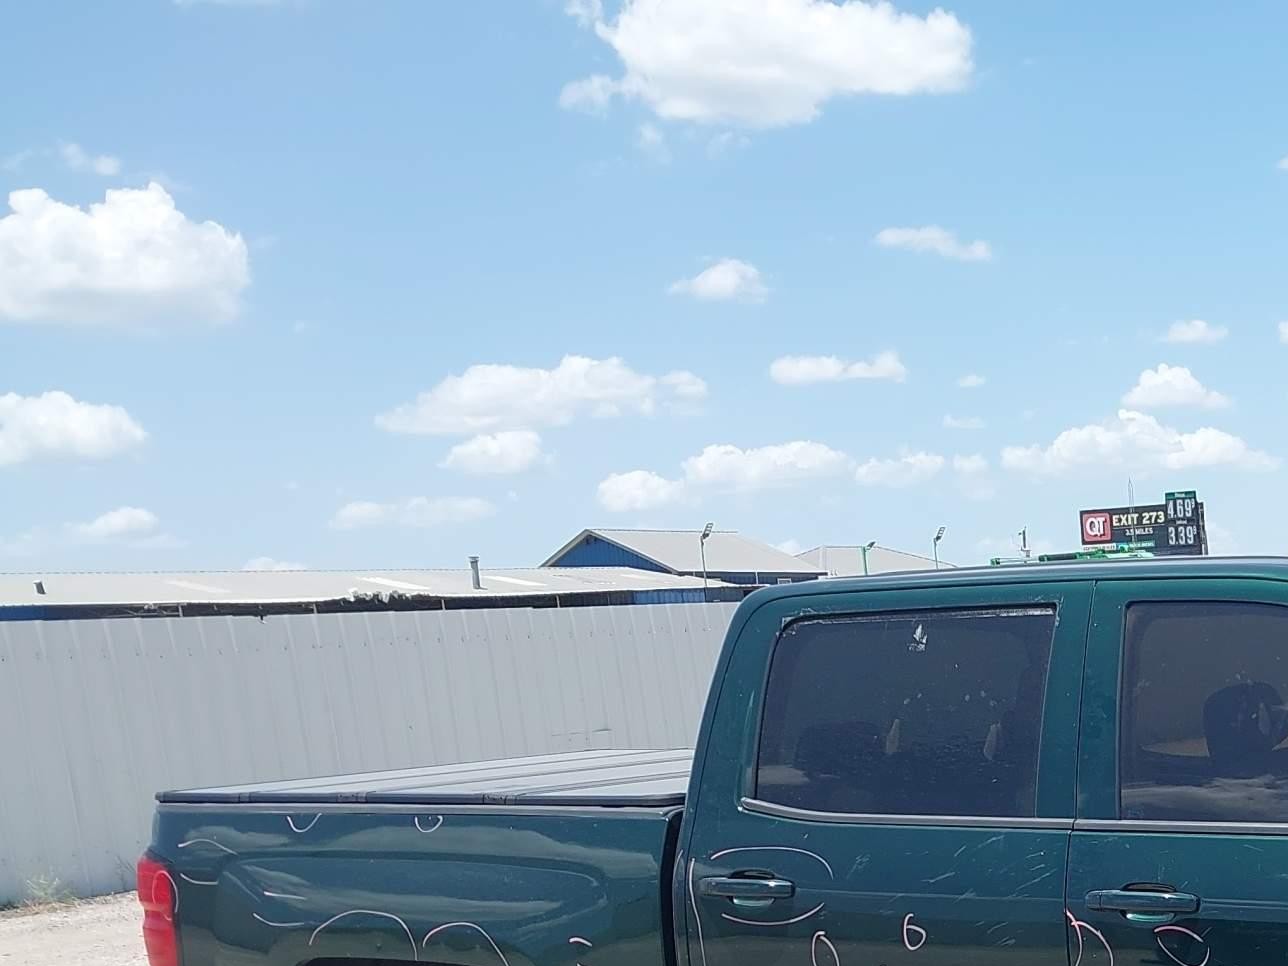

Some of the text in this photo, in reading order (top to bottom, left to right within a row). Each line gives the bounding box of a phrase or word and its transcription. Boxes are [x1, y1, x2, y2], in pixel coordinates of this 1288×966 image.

[1086, 517, 1105, 536] QT
[1112, 512, 1165, 526] EXIT 273
